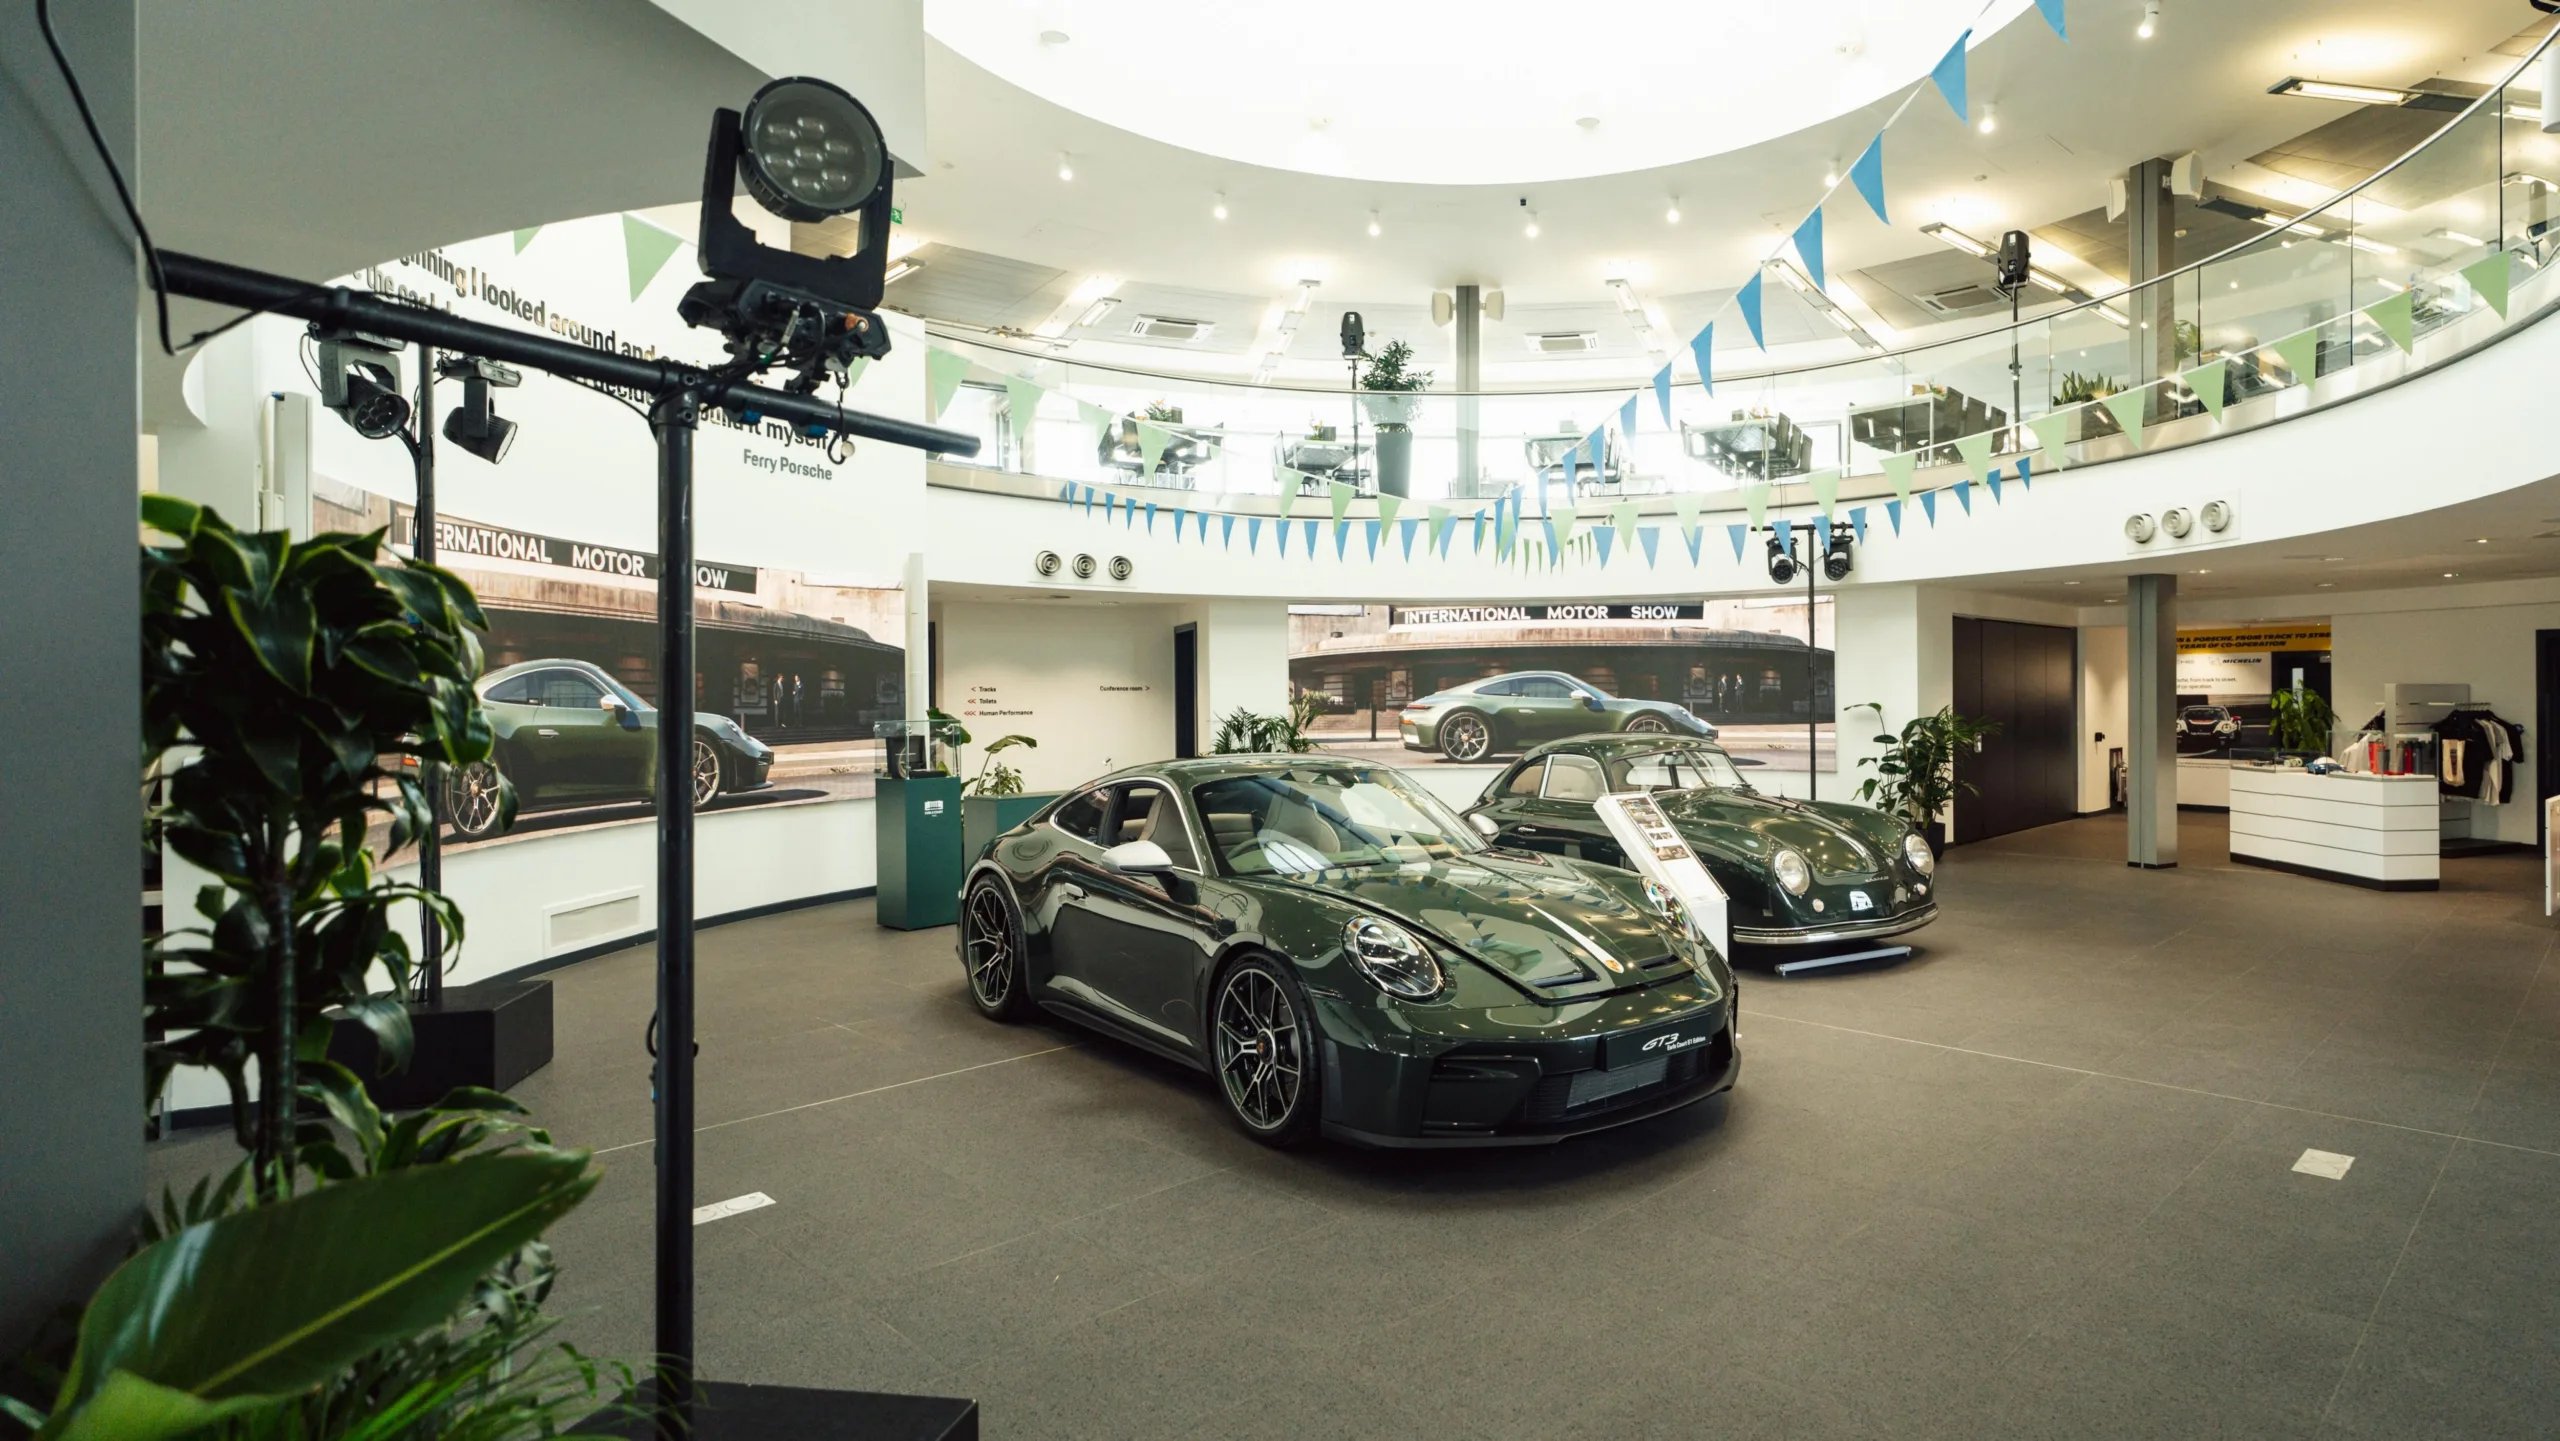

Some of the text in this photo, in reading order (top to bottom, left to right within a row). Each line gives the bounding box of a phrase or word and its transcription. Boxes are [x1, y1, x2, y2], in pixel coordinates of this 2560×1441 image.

[482, 271, 546, 327] looked
[550, 312, 616, 352] around
[743, 448, 833, 480] Ferry Porsche
[406, 517, 553, 564] IERNATIONAL
[572, 544, 646, 577] MOTOR
[1404, 605, 1679, 624] INTERNATIONAL MOTOR SHOW
[1641, 1033, 1679, 1050] GT3
